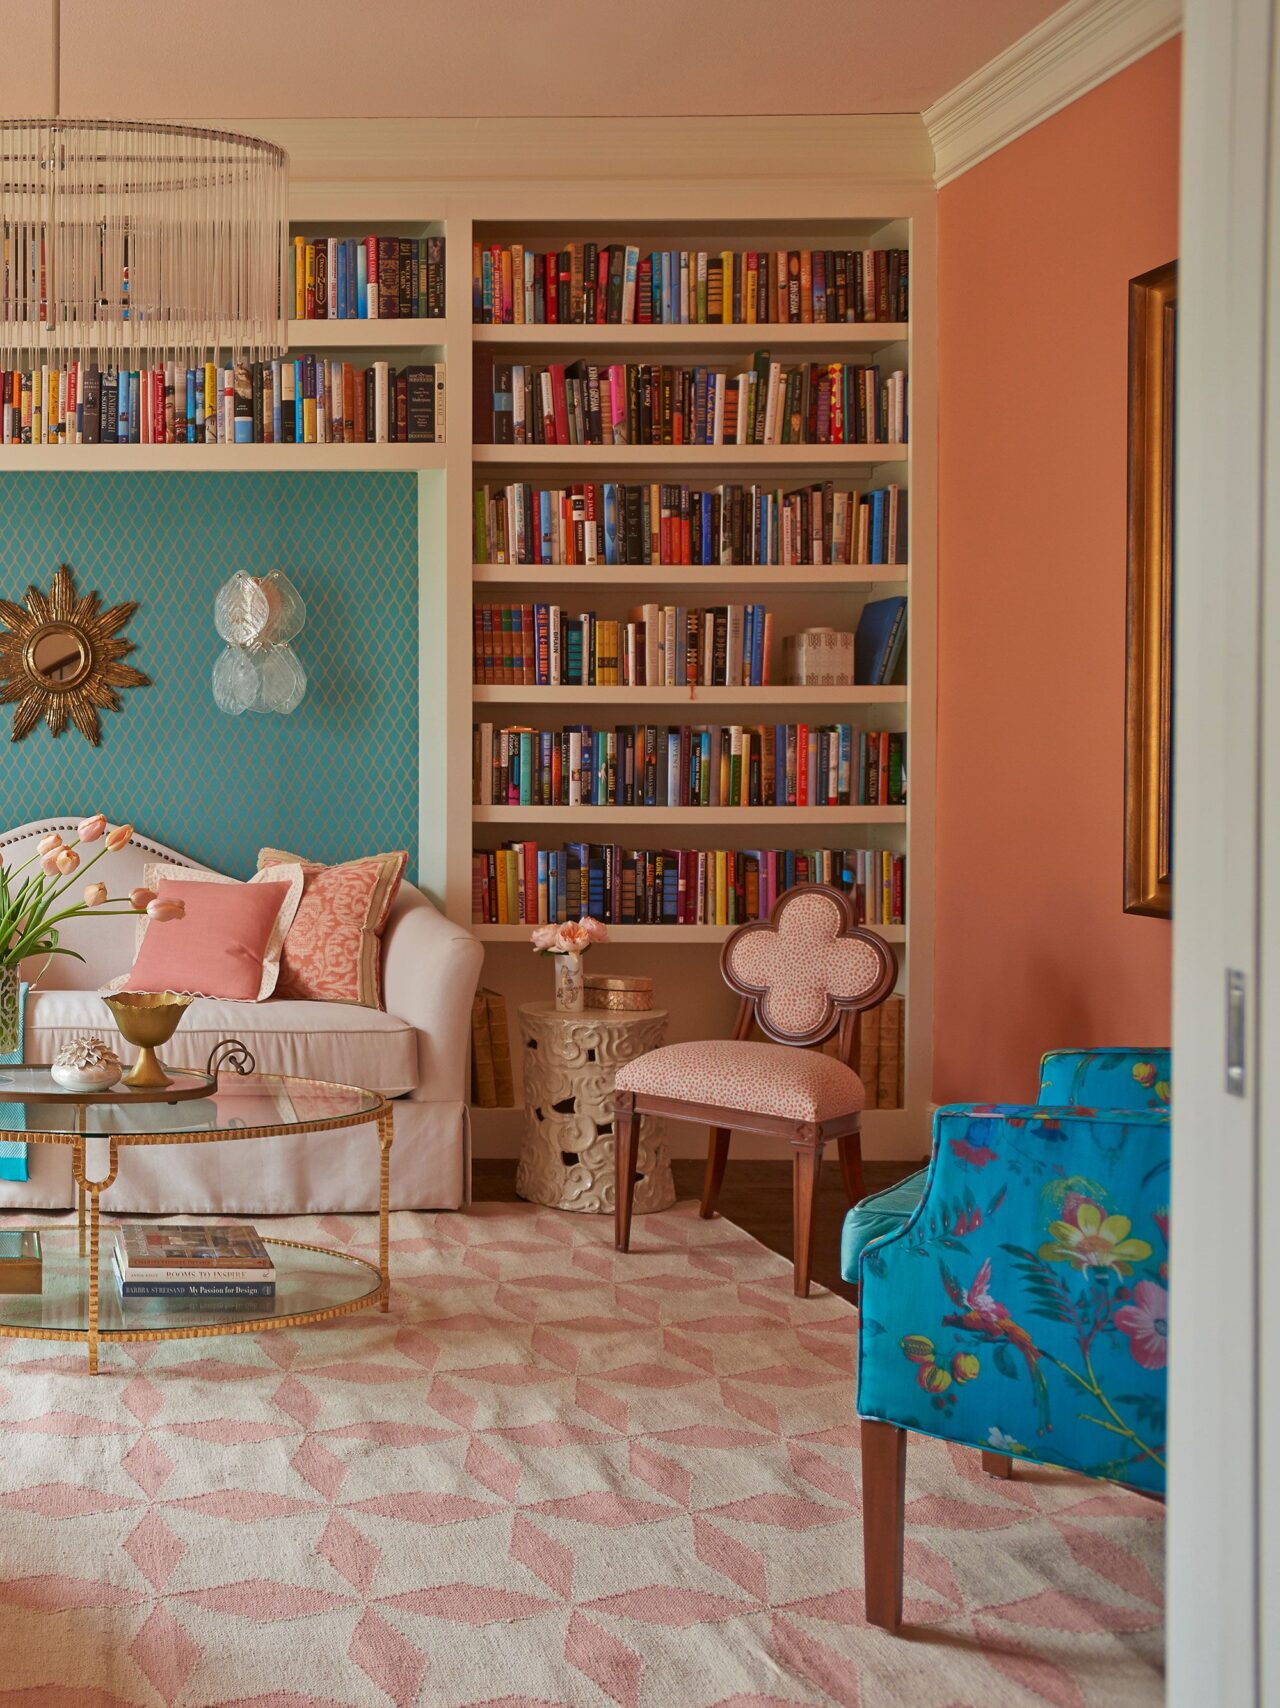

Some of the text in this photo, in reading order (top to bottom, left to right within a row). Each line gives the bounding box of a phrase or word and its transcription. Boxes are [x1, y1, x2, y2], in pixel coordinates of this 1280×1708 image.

[790, 280, 799, 314] JOHN GRISHAM
[590, 388, 600, 412] GRISHAM
[108, 390, 116, 433] LINDBERGH
[539, 626, 548, 637] THE
[166, 1271, 247, 1279] ROOMS TO INSPIRE
[126, 1286, 185, 1295] BARBRA STREISAND
[188, 1285, 258, 1296] My Passion for Design
